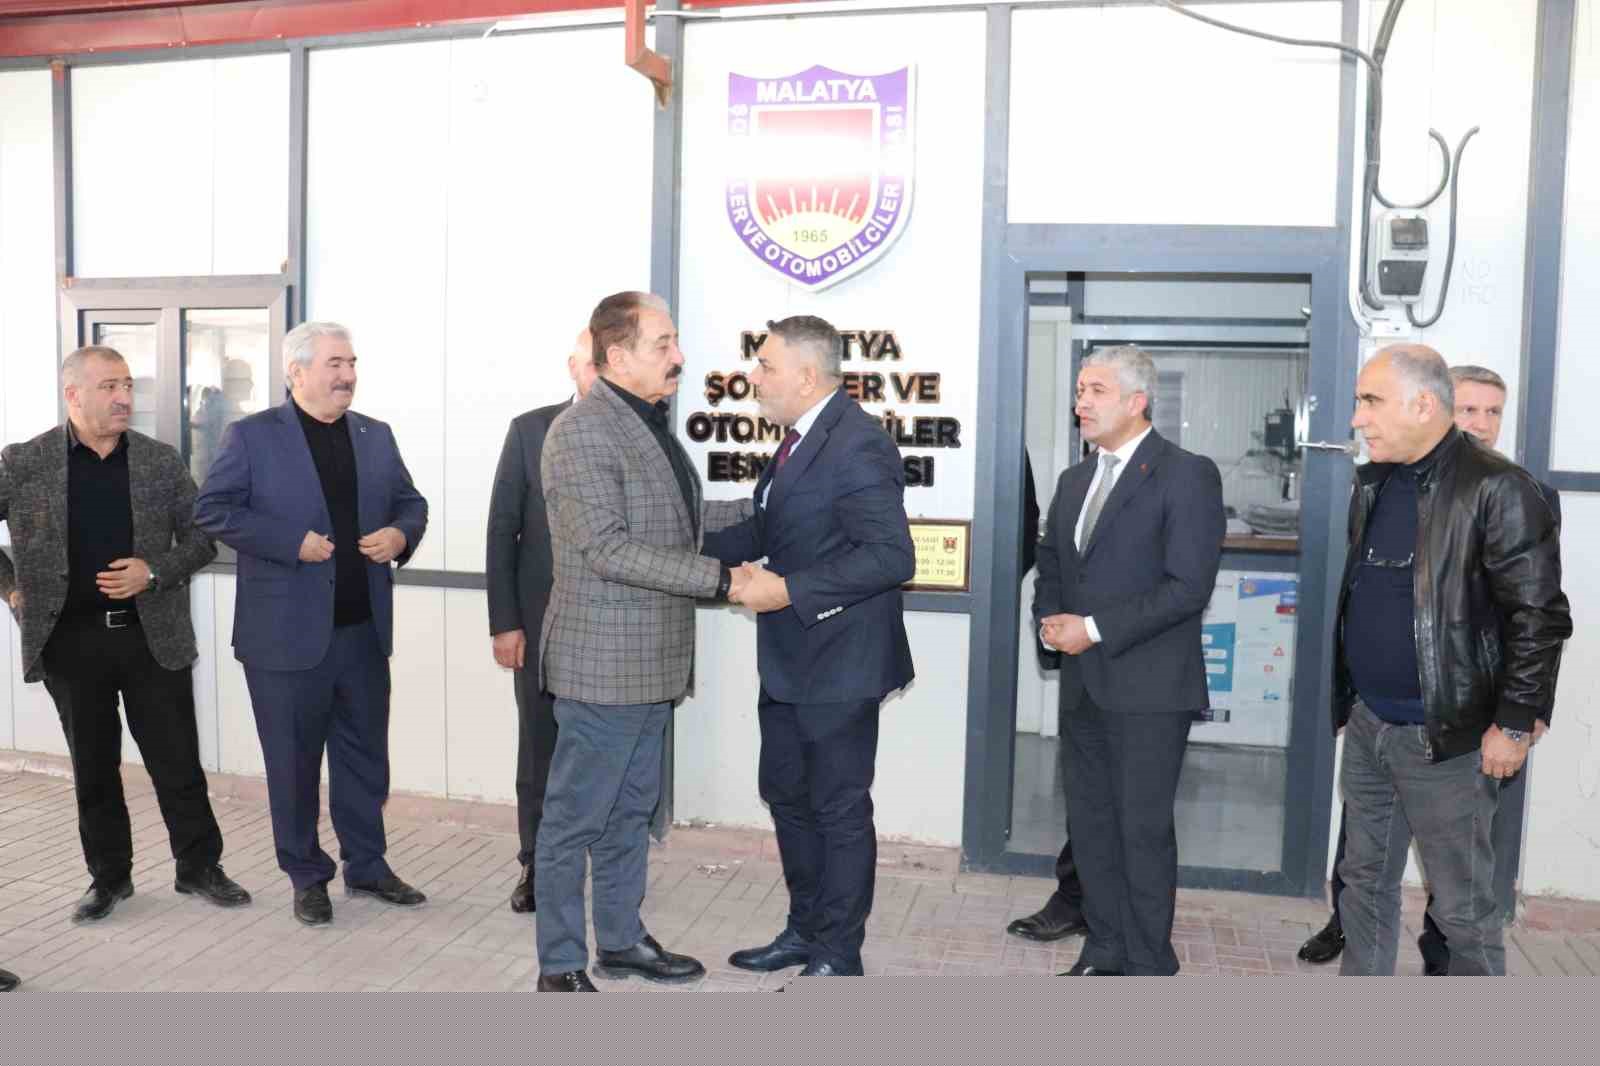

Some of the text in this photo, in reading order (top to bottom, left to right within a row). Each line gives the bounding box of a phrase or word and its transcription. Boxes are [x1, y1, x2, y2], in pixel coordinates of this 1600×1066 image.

[756, 80, 877, 102] MALATYA
[741, 222, 767, 249] VE
[764, 183, 900, 278] OTOMOBİLCİLER
[793, 230, 828, 243] 1965
[741, 331, 901, 361] MTYA
[705, 371, 941, 406] ŞOER VE
[686, 408, 961, 449] OTOMİLER
